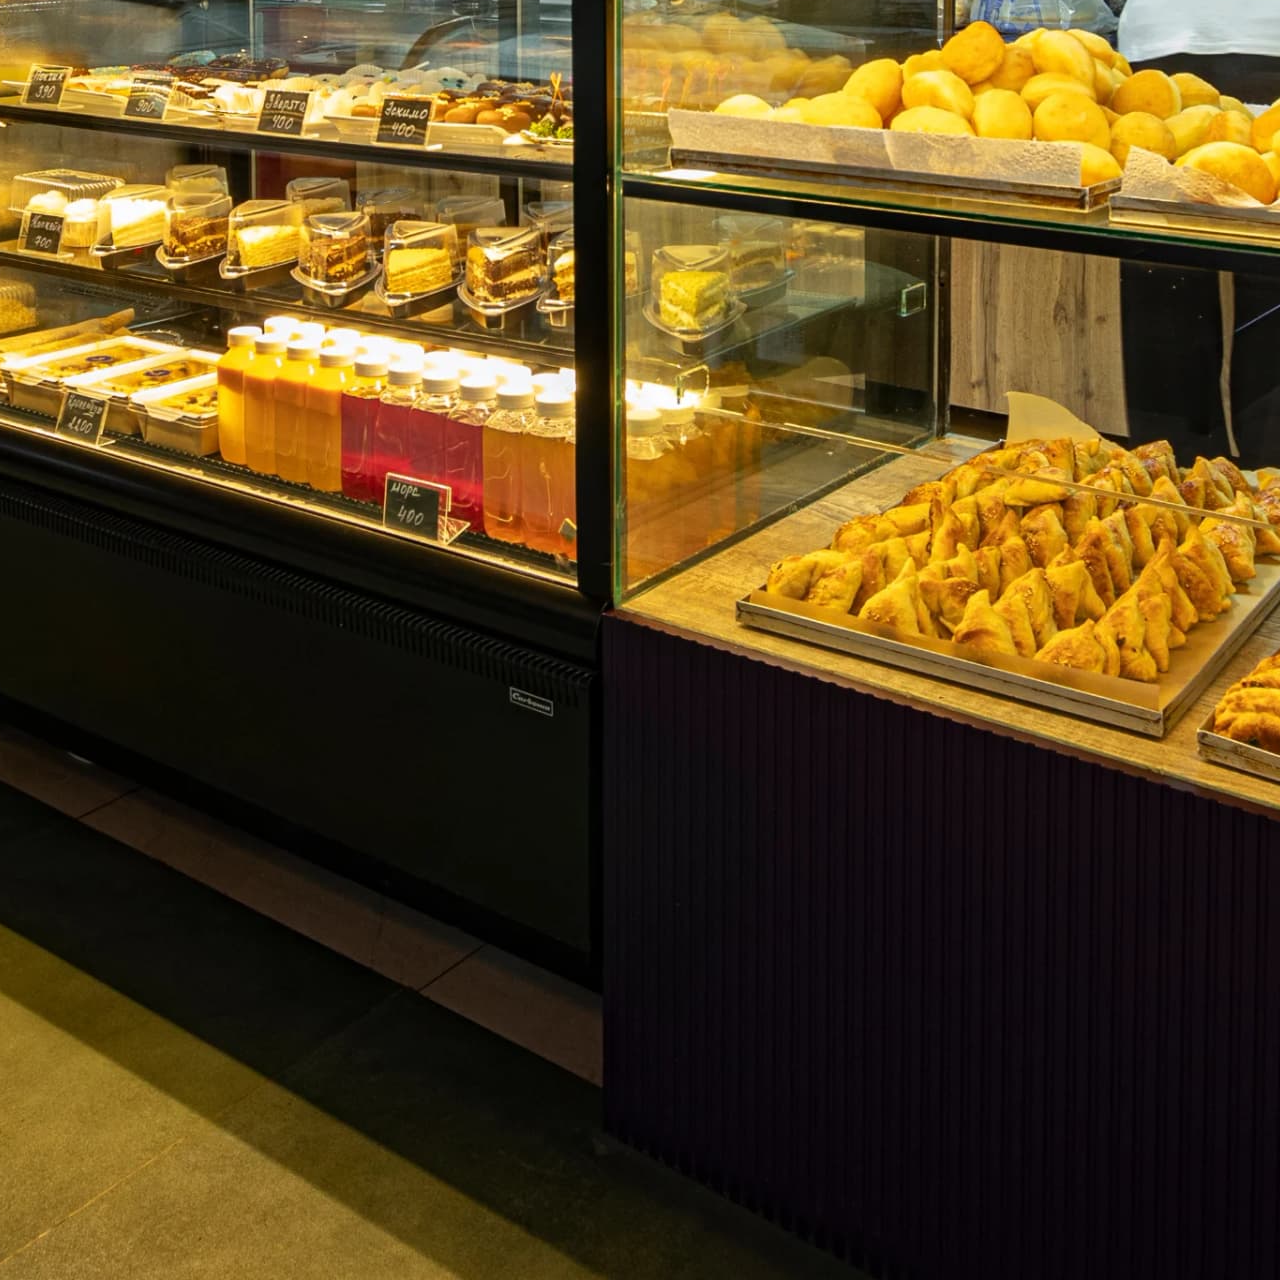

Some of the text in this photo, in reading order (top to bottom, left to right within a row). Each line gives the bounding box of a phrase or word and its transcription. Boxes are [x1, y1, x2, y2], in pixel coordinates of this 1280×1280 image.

[271, 115, 294, 130] 400
[391, 121, 417, 138] 400
[397, 504, 425, 527] 400
